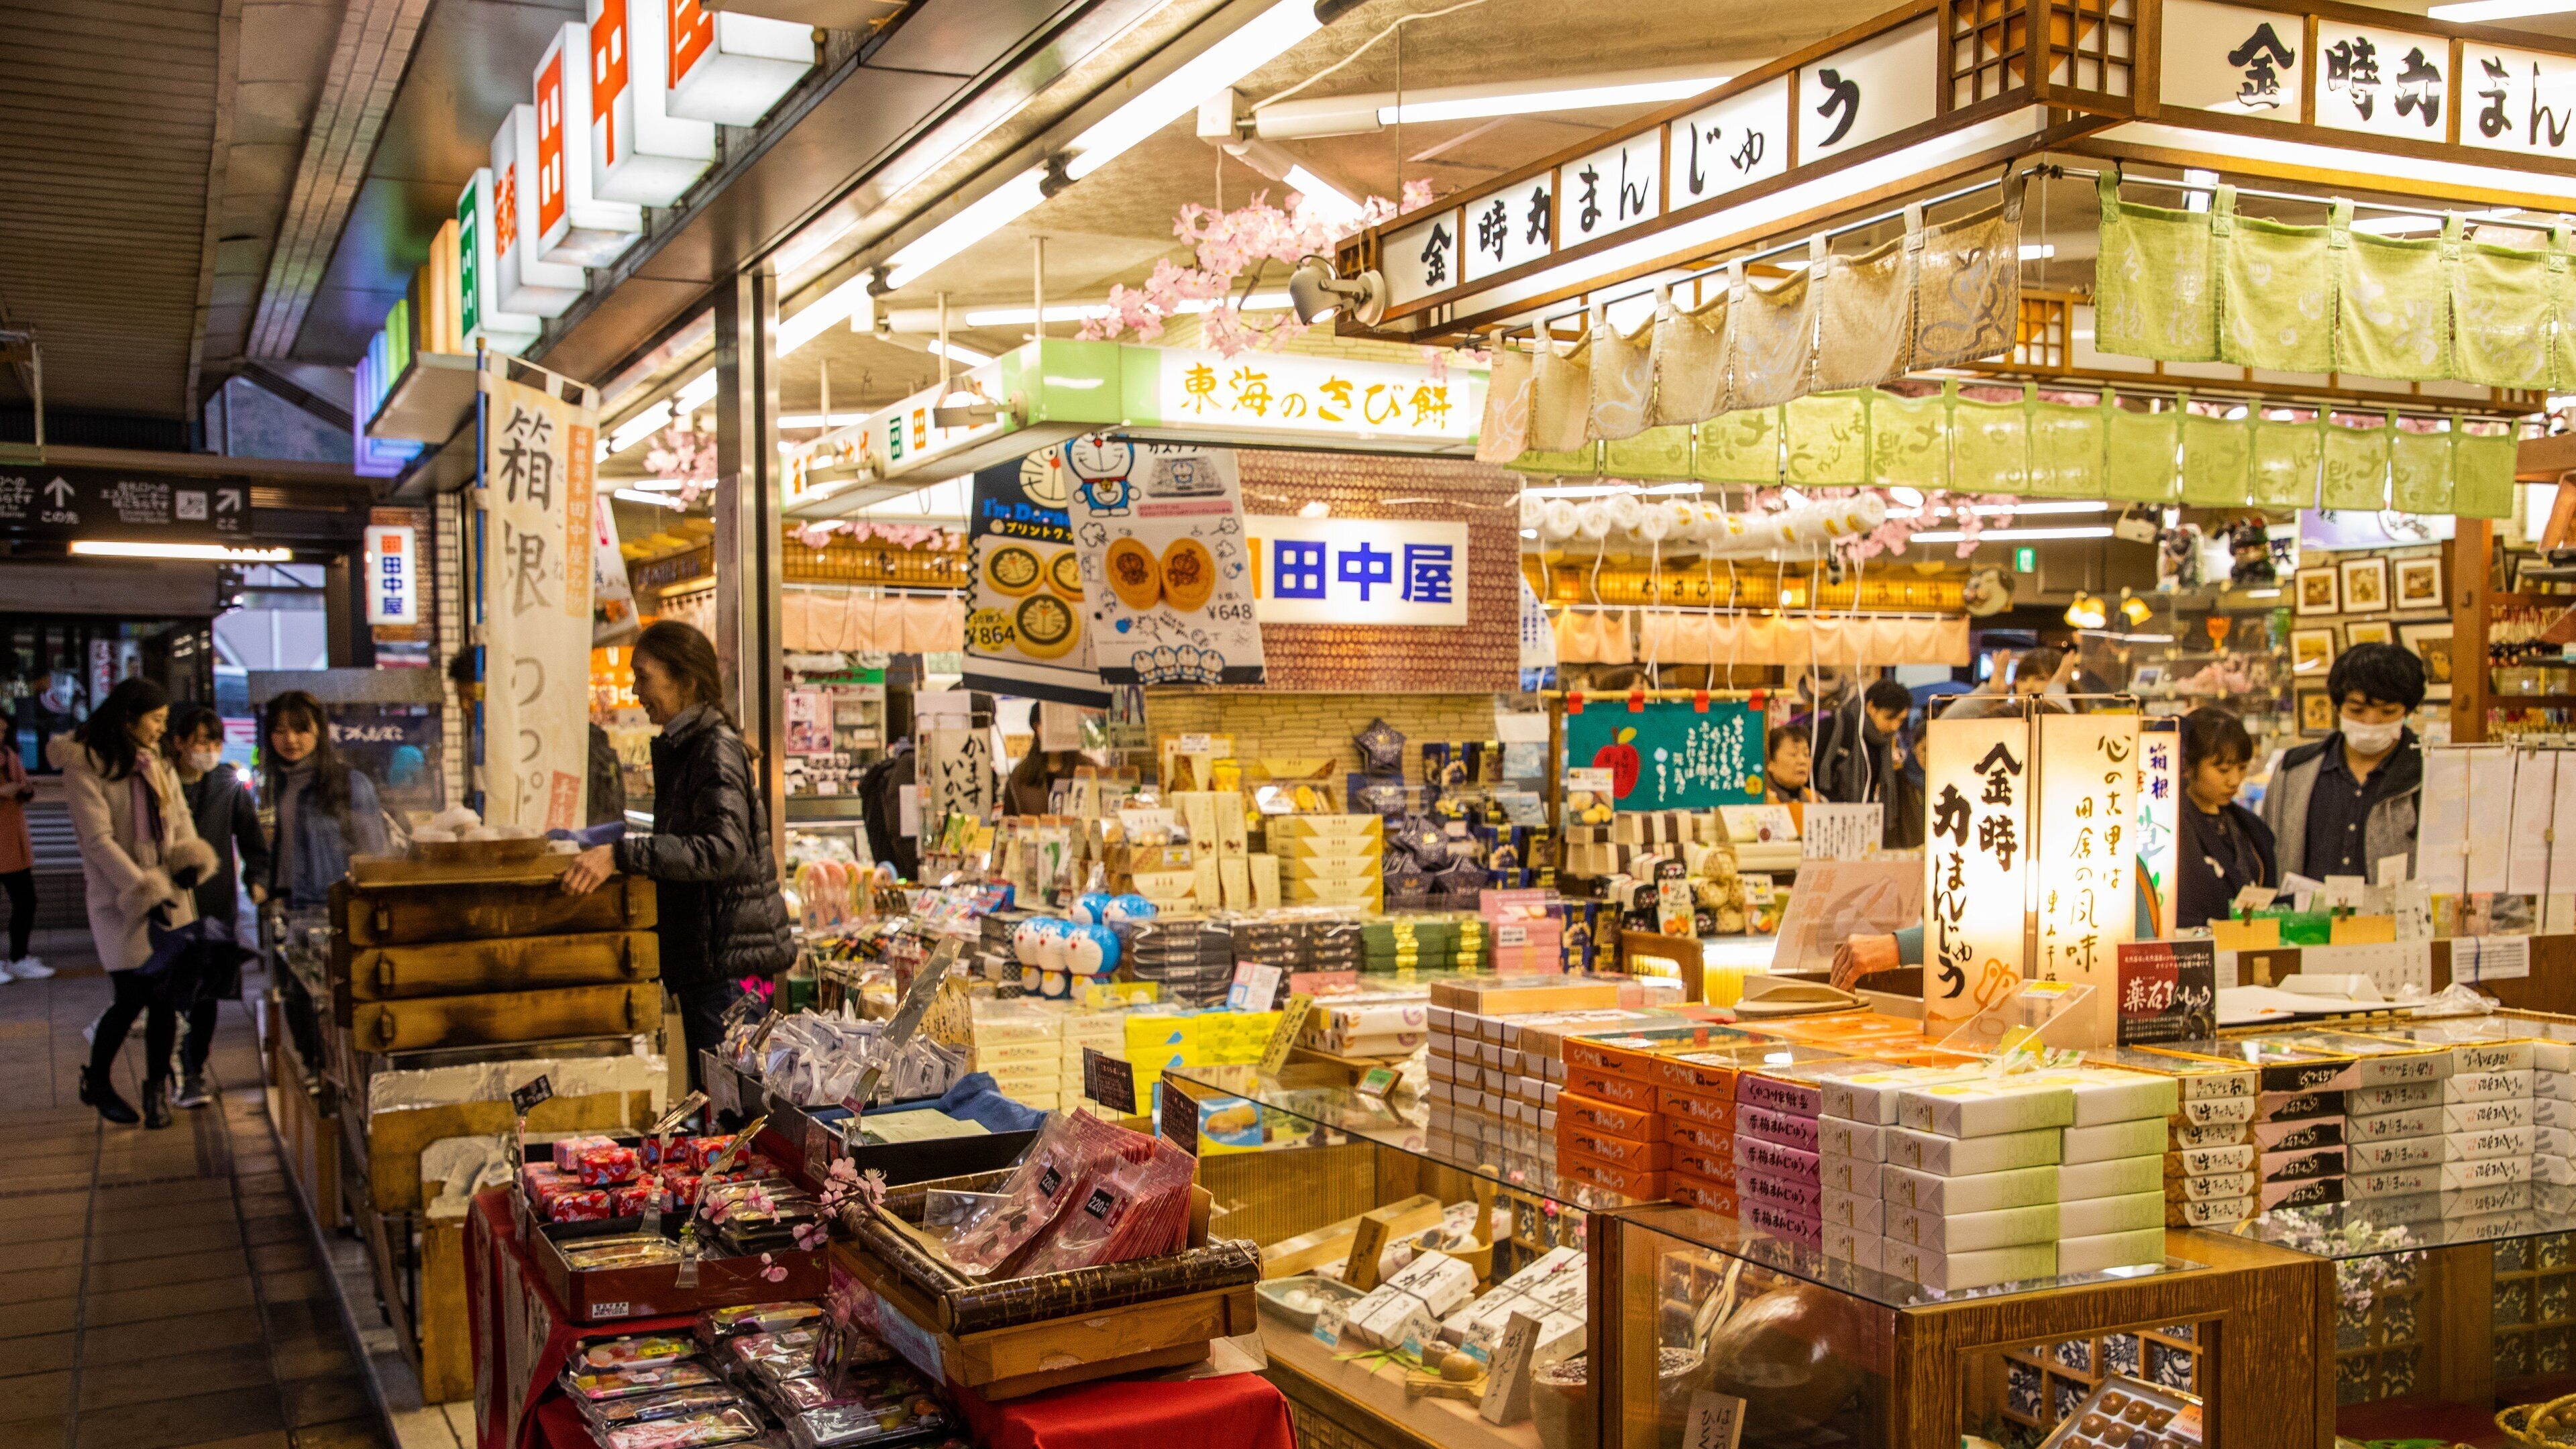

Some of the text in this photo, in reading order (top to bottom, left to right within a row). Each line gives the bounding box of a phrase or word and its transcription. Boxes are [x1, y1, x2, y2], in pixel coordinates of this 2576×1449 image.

[1420, 68, 1861, 288] 金時力まんじゅう
[1180, 362, 1453, 431] 東海のきび餅
[380, 555, 404, 615] 田中屋
[1273, 539, 1453, 604] 田中屋
[1208, 604, 1252, 621] ¥648
[2149, 741, 2169, 801] 箱根
[1974, 742, 2022, 871] 金時
[1933, 784, 1972, 998] 力まんじゅう
[1749, 1084, 1809, 1110] 香梅まんじゅう
[1750, 1114, 1807, 1140] 香梅まんじゅう
[1748, 1146, 1805, 1173] 香梅まんじゅう
[1749, 1178, 1805, 1204] 香梅まんじゅう
[1752, 1208, 1807, 1236] 香梅まんじゅう
